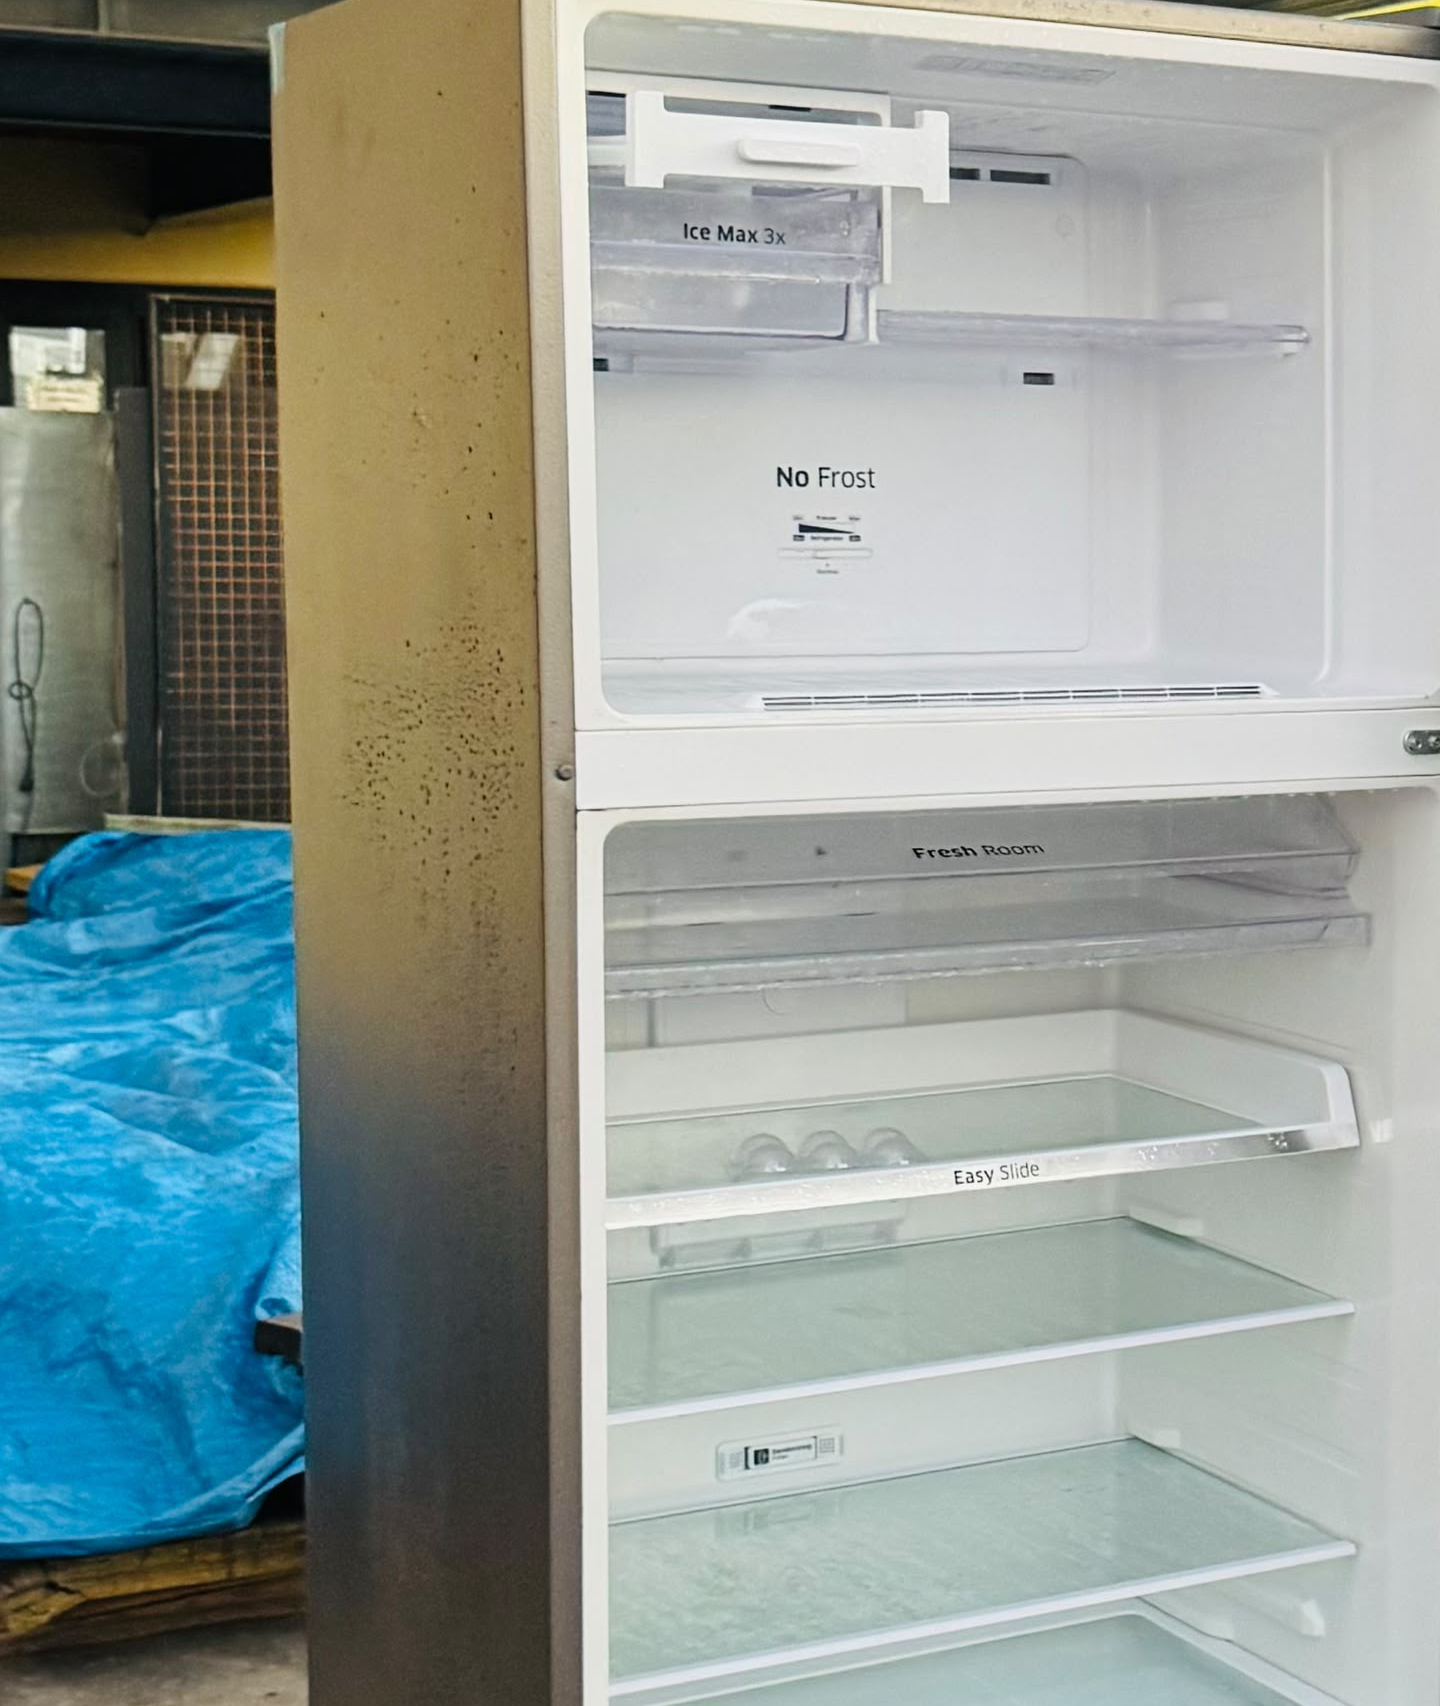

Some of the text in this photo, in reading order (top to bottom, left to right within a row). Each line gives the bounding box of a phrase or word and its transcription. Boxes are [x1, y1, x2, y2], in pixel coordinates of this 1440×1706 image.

[683, 222, 786, 245] Ice Max 3x
[777, 466, 876, 488] No Frost
[912, 845, 1045, 859] Fresh Room
[953, 1162, 1040, 1185] Easy Slide
